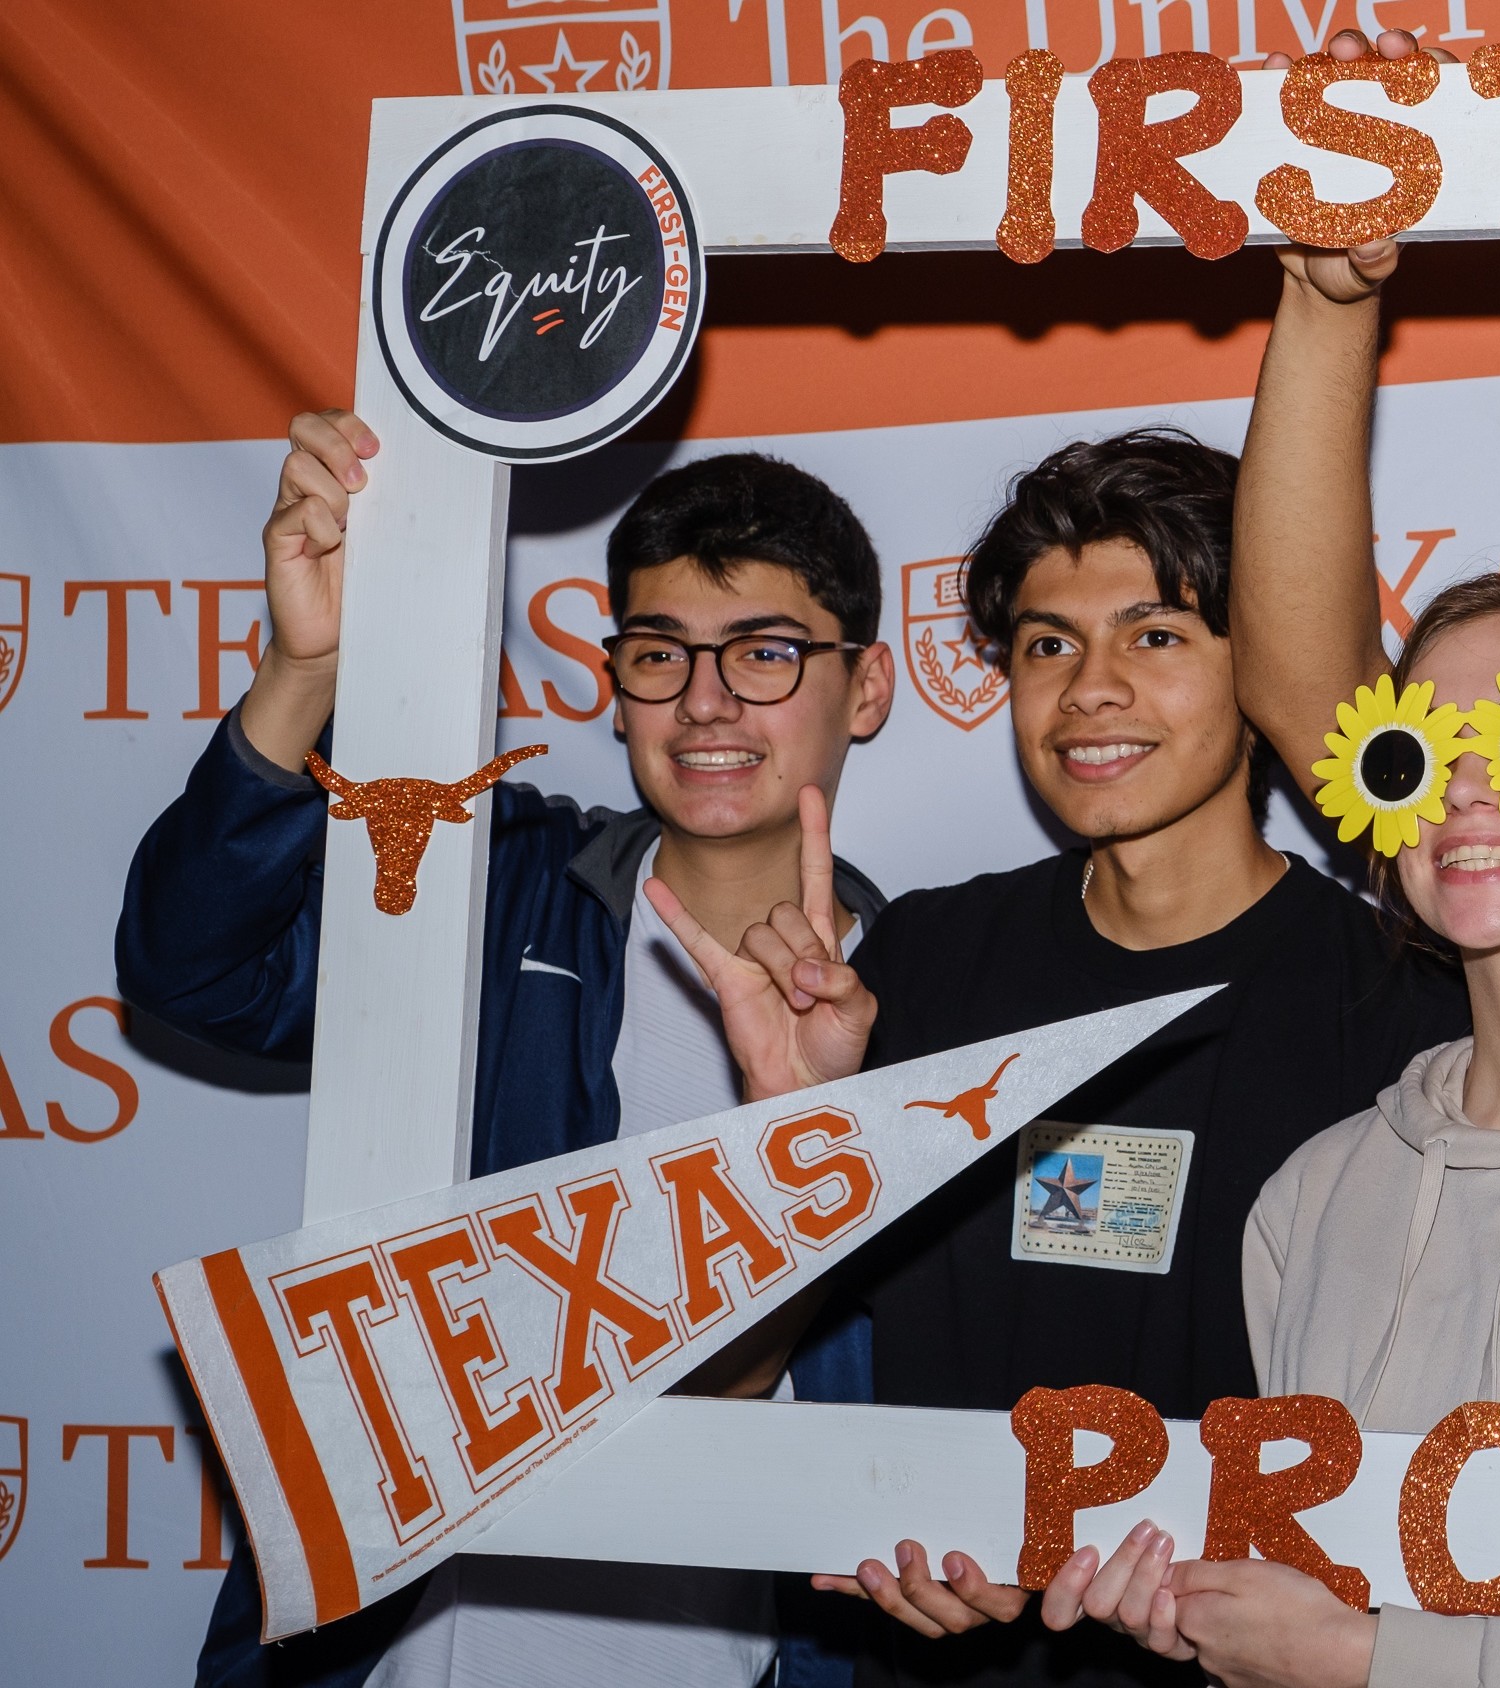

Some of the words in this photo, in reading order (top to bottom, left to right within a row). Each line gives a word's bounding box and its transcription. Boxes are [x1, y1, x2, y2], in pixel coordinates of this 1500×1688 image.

[420, 226, 643, 362] Equity
[637, 164, 689, 331] FIRST-GEN
[268, 1104, 882, 1547] TEXAS
[456, 1506, 480, 1528] product
[490, 1473, 525, 1500] trademarks
[531, 1459, 544, 1470] The
[543, 1436, 573, 1461] University
